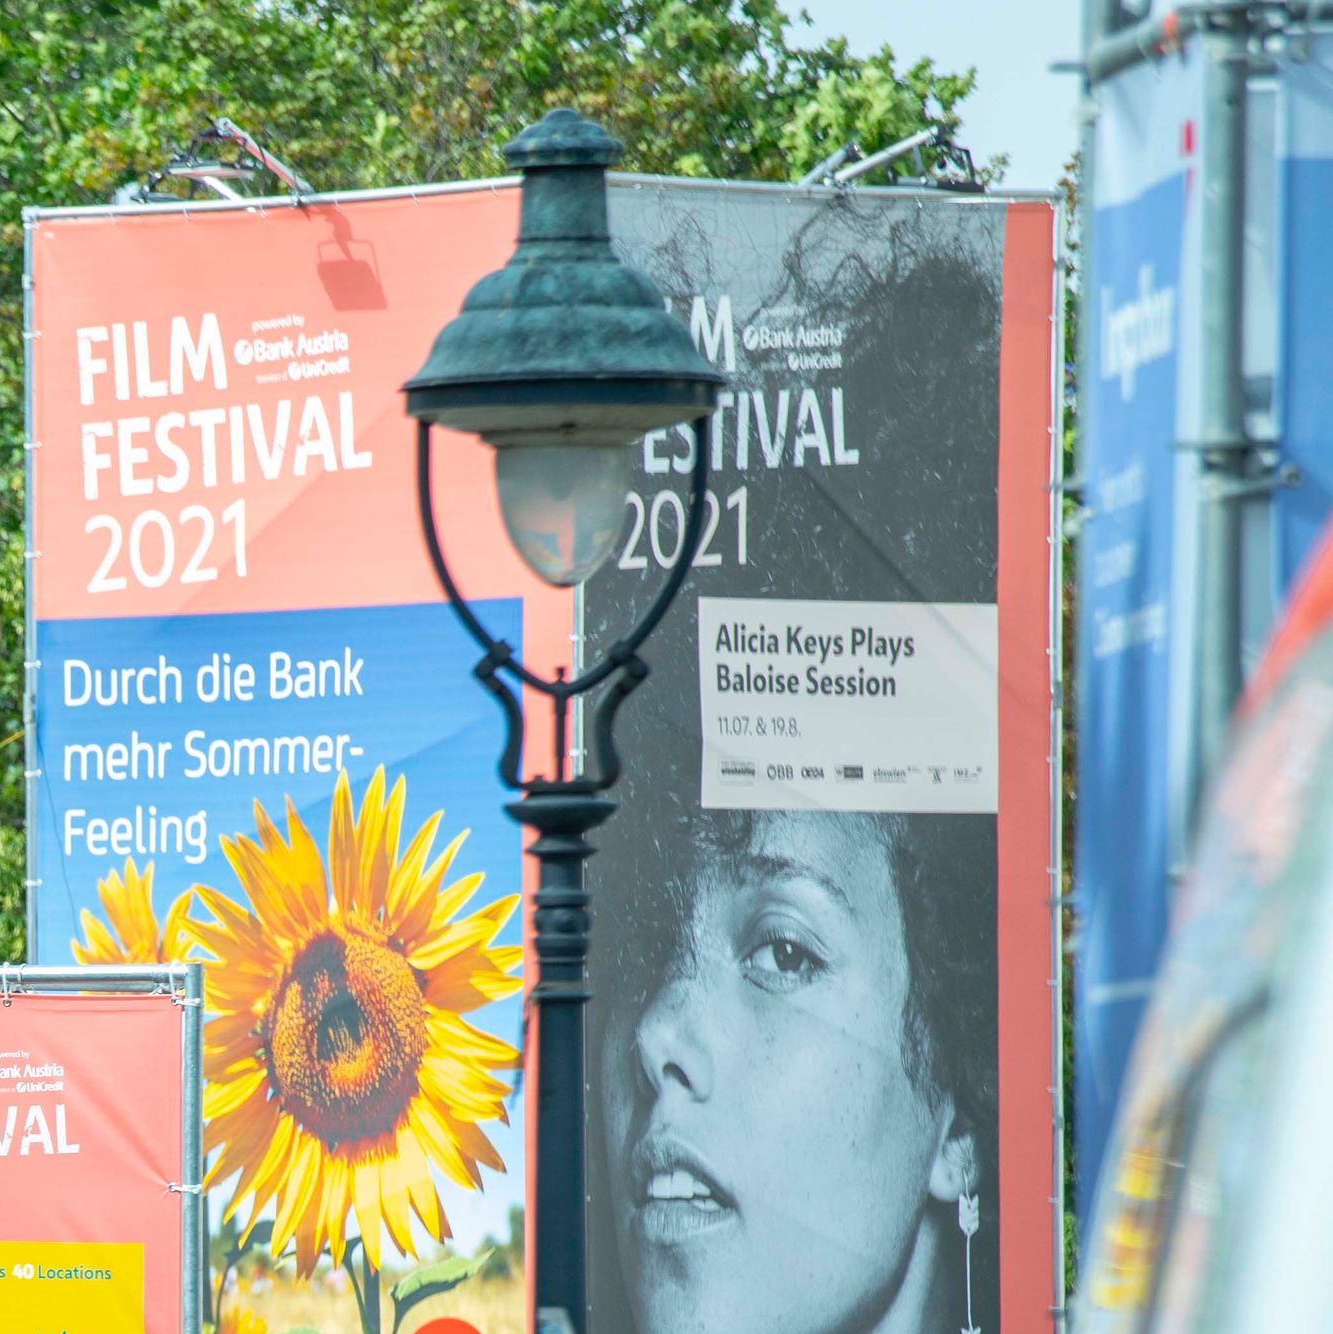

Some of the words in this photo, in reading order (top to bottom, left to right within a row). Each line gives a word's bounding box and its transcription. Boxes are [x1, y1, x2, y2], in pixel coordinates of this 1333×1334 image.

[253, 336, 294, 362] Bank
[296, 328, 349, 357] Austria
[759, 327, 793, 349] Bank
[797, 324, 843, 347] Austria
[76, 313, 228, 405] FILM
[799, 352, 842, 370] UniCredit
[81, 392, 373, 500] FESTIVAL
[84, 499, 247, 593] 2021
[618, 485, 748, 570] 2021
[716, 622, 779, 657] Alicia
[786, 625, 844, 664] Keys
[851, 627, 915, 665] Plays
[63, 655, 182, 707] Durch
[196, 654, 255, 702] die
[269, 647, 364, 698] Bank
[716, 664, 799, 695] Baloise
[806, 666, 896, 696] Session
[717, 716, 753, 737] 11.07.
[756, 718, 767, 737] &
[63, 730, 171, 781] mehr
[184, 730, 364, 778] Sommer-
[63, 806, 207, 864] Feeling
[23, 1063, 64, 1078] Austria
[27, 1081, 64, 1092] UniCredit
[12, 1263, 35, 1279] 40
[38, 1264, 112, 1281] Locations
